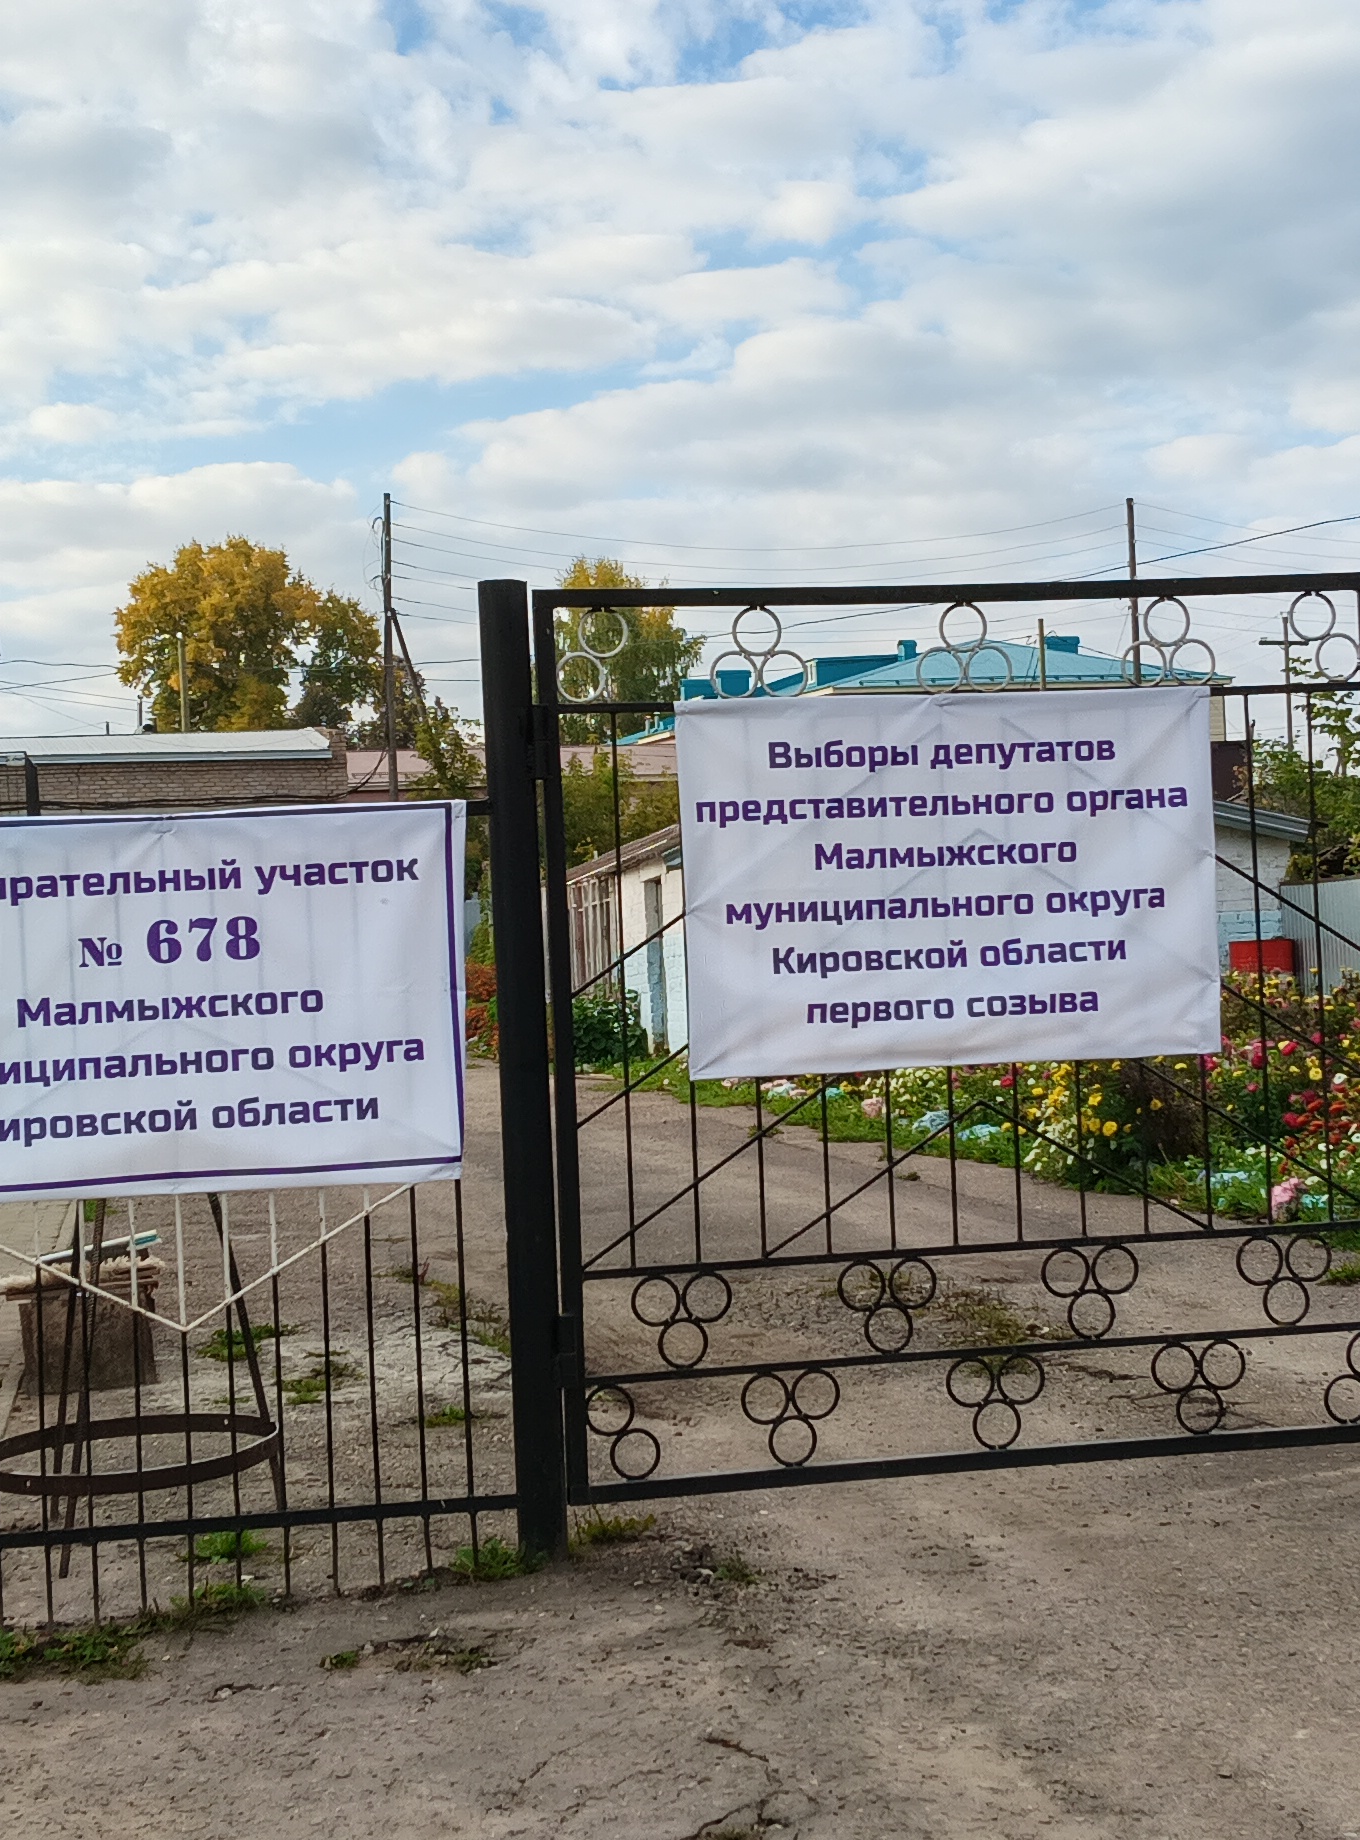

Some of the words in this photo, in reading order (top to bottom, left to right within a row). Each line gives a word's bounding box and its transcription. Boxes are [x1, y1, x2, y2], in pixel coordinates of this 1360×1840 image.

[768, 739, 919, 773] Выборы
[929, 739, 1116, 770] депутатов
[695, 791, 1054, 828] представительного
[1066, 786, 1188, 818] органа
[814, 841, 1077, 871] Малмыжского
[253, 857, 419, 896] участок
[725, 893, 1034, 930] муниципального
[1045, 887, 1165, 918] округа
[77, 936, 123, 968] №
[146, 915, 261, 964] 678
[772, 939, 968, 979] Кировской
[979, 937, 1127, 967] области
[16, 988, 324, 1029] Малмыжского
[806, 998, 955, 1029] первого
[966, 991, 1099, 1018] созыва
[288, 1037, 425, 1073] округа
[211, 1096, 379, 1129] области
